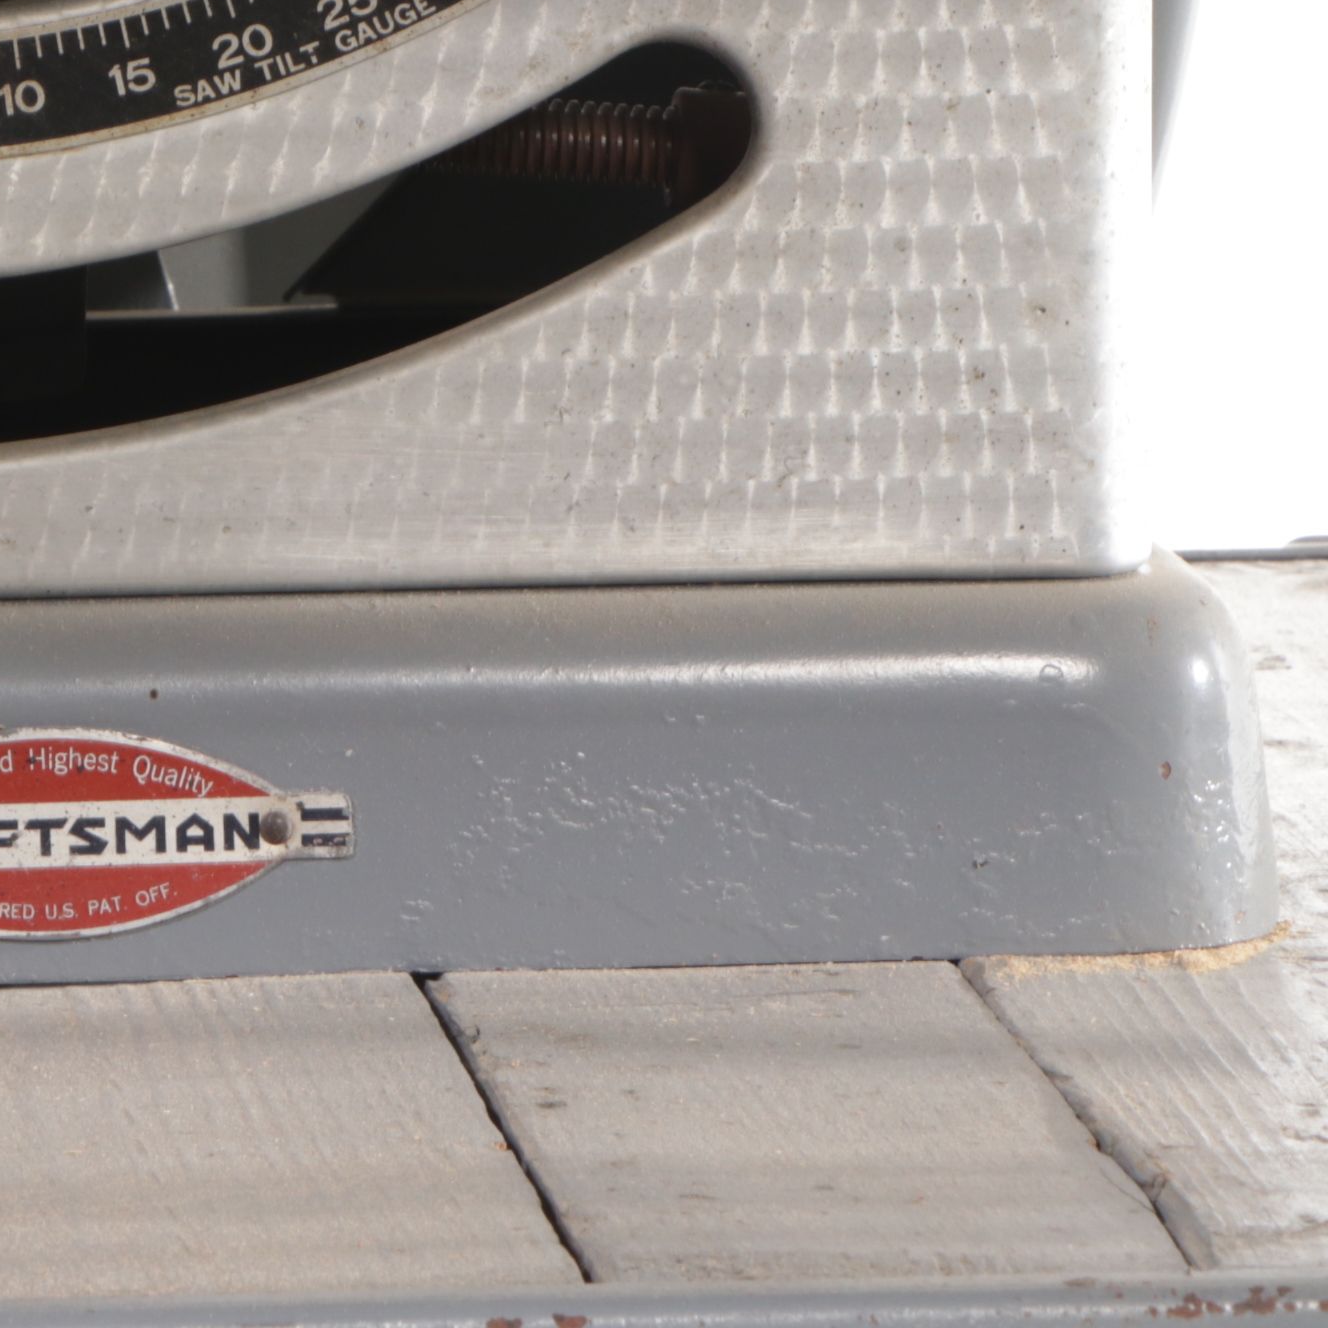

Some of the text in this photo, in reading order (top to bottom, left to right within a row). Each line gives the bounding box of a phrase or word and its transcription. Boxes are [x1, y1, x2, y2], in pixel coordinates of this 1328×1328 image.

[108, 57, 156, 96] 15
[212, 23, 273, 69] 20
[174, 69, 242, 107] SAW
[254, 41, 320, 82] TILT
[29, 747, 119, 775] Highest
[132, 755, 213, 797] Quality
[135, 883, 178, 907] OFF.
